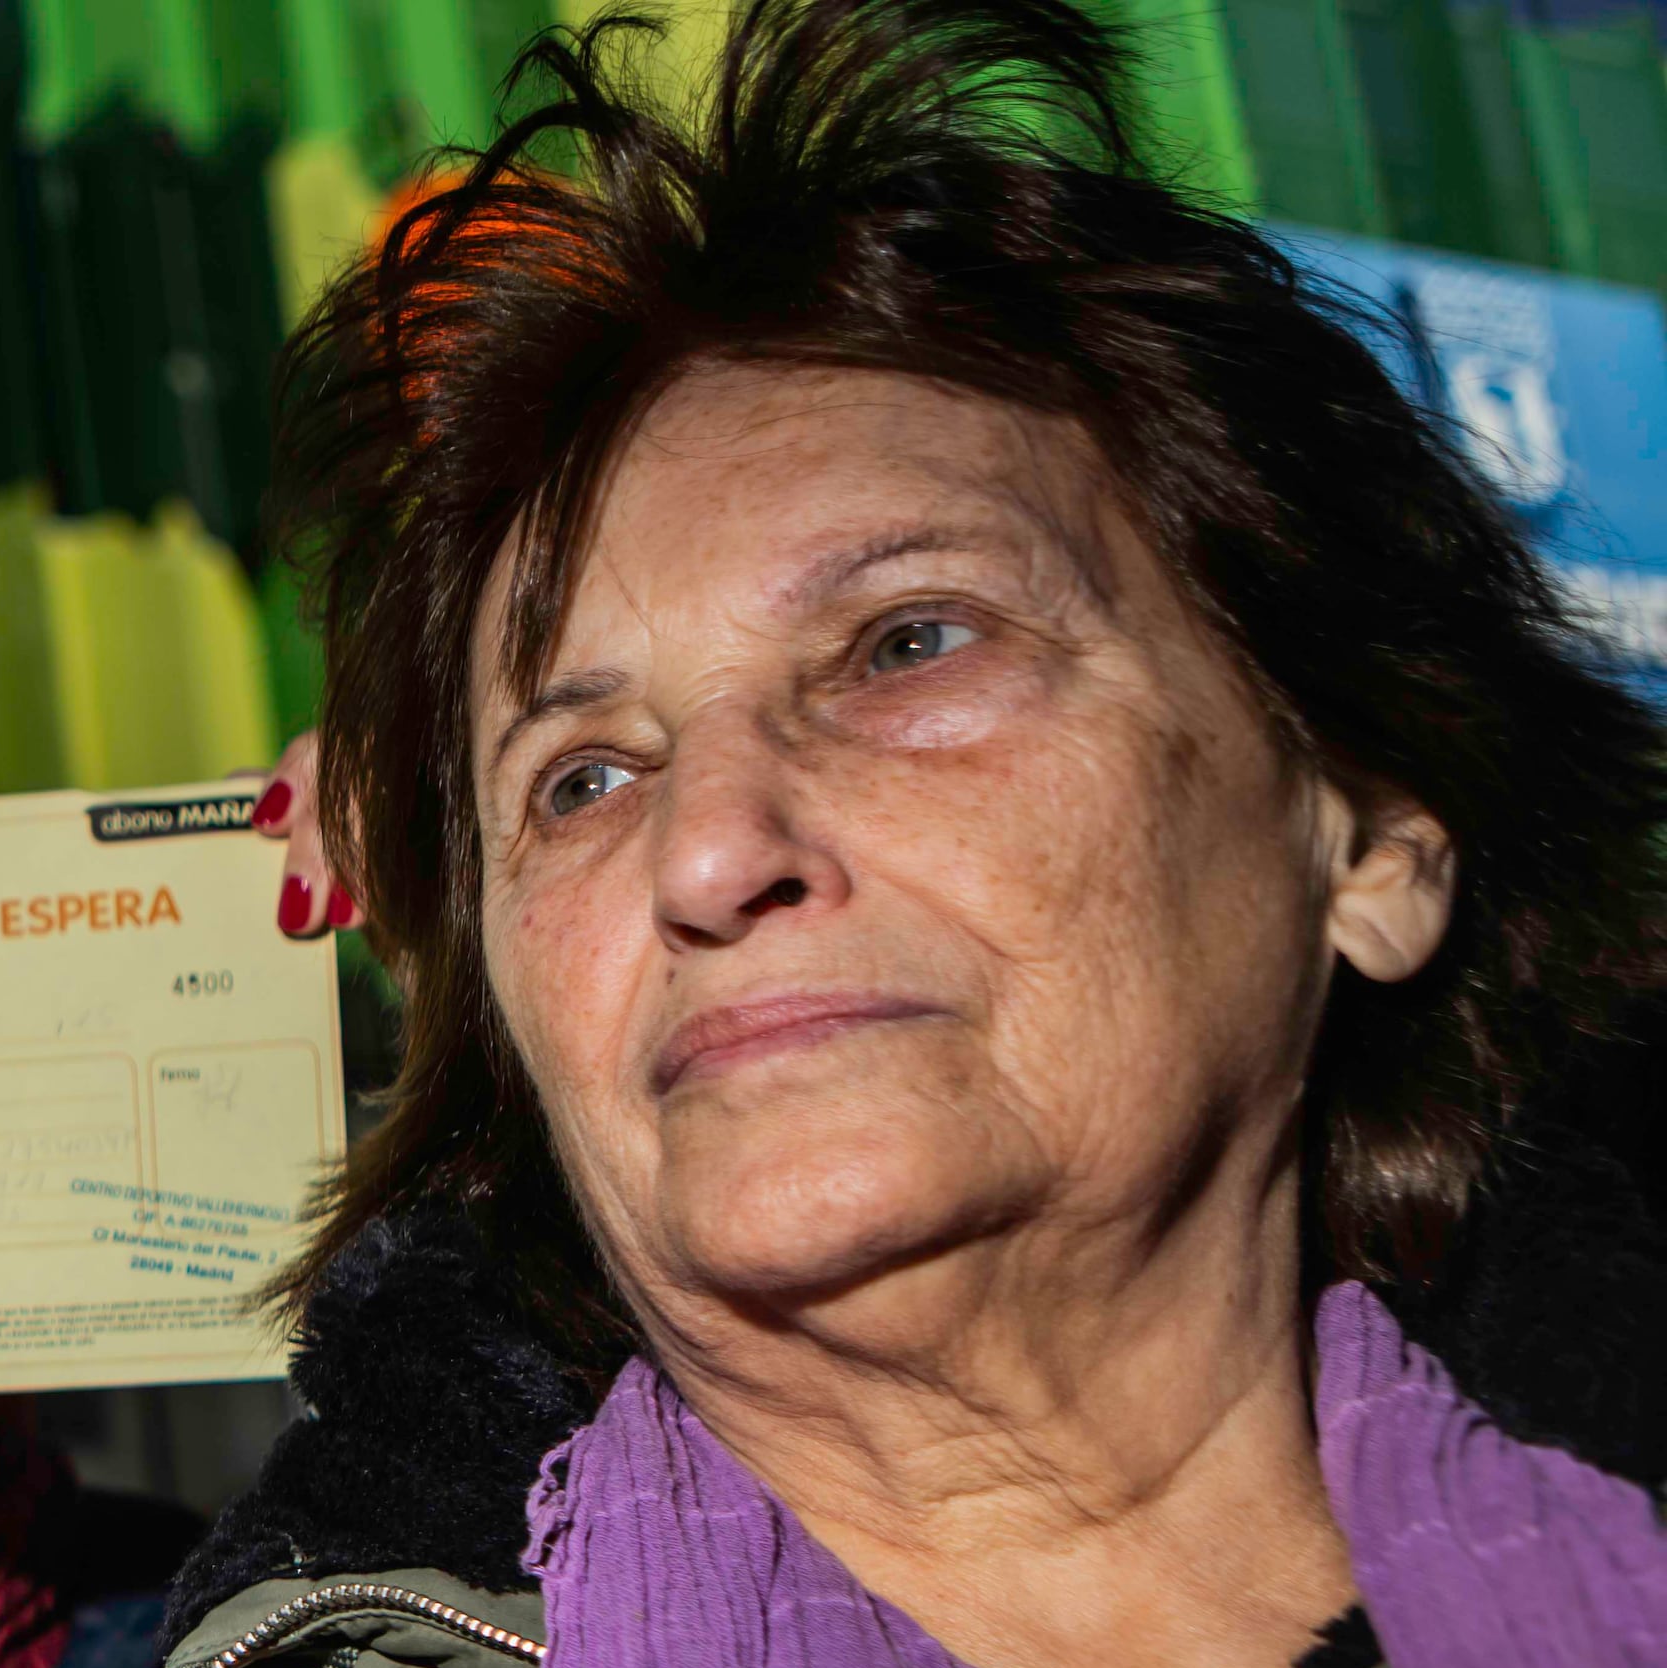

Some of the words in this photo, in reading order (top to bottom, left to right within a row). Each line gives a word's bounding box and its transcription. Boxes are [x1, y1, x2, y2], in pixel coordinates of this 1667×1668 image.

[101, 811, 170, 836] abono
[0, 885, 182, 939] ESPERA
[193, 1242, 213, 1256] del
[186, 1263, 234, 1284] Madrid
